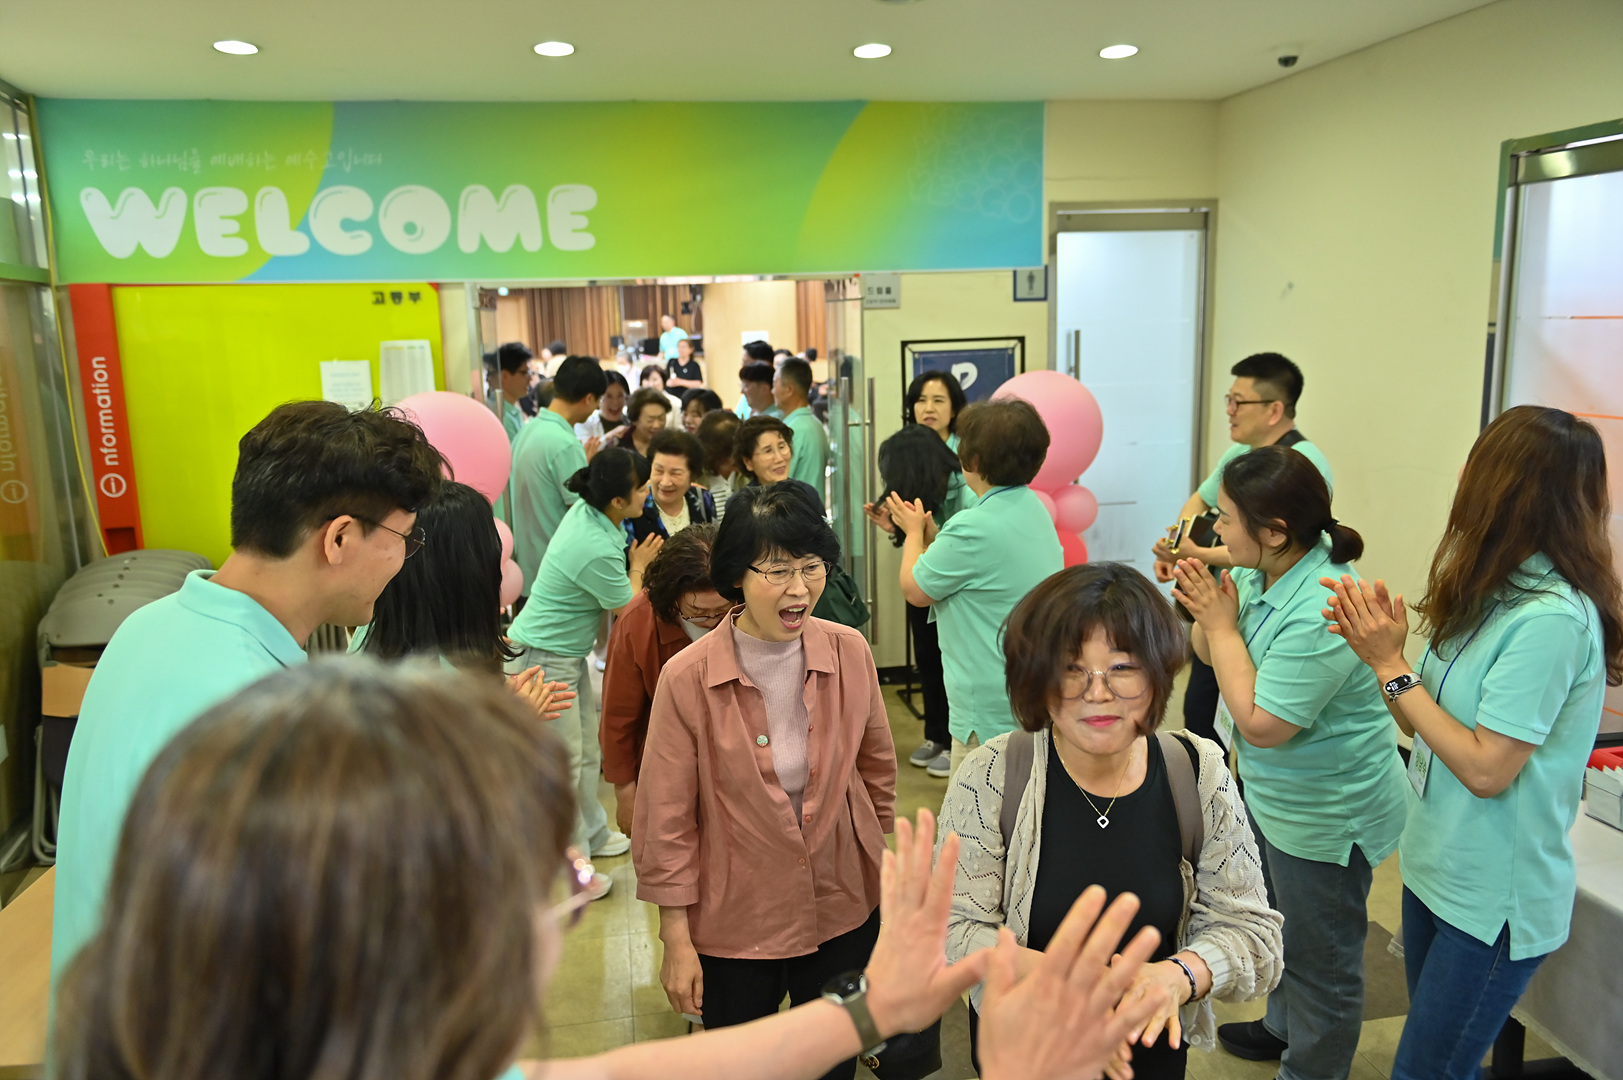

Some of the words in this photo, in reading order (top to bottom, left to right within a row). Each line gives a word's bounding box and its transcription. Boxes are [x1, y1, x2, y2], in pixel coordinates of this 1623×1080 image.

[82, 149, 131, 172] 우리는
[139, 147, 203, 175] 하나님을
[210, 150, 276, 172] 예배하는
[80, 183, 598, 259] WELCOME
